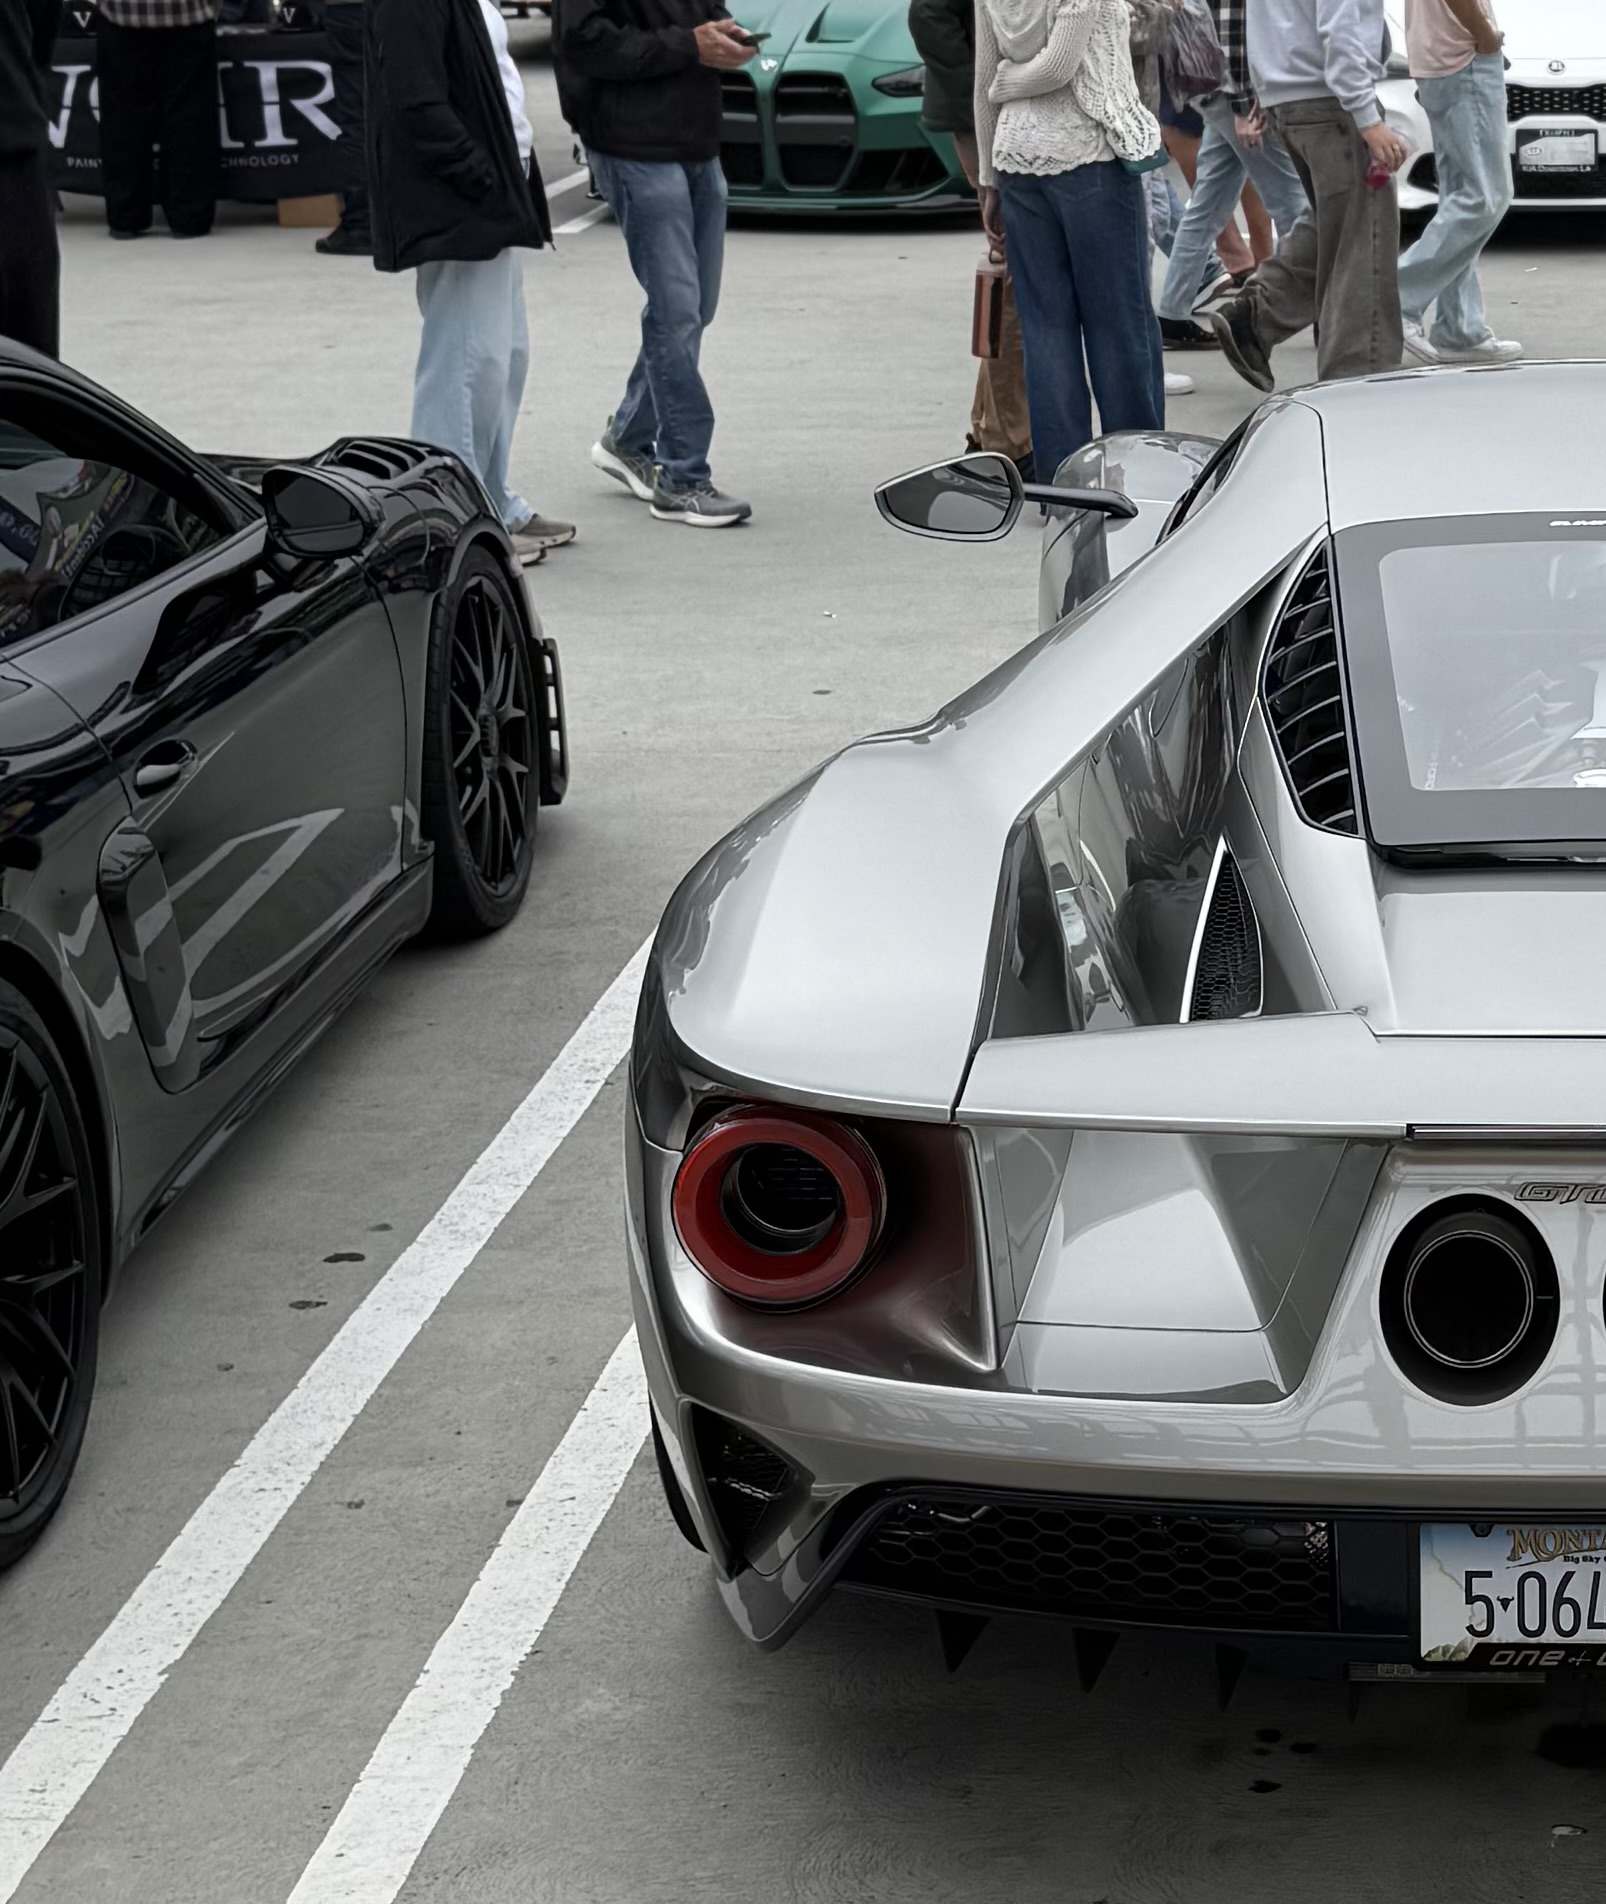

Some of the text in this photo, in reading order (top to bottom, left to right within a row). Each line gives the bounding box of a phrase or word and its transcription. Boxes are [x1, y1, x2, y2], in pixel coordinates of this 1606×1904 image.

[72, 11, 92, 29] V
[282, 7, 297, 24] V
[1562, 1554, 1580, 1565] Big
[1581, 1554, 1601, 1565] Sky
[1489, 1649, 1564, 1667] one
